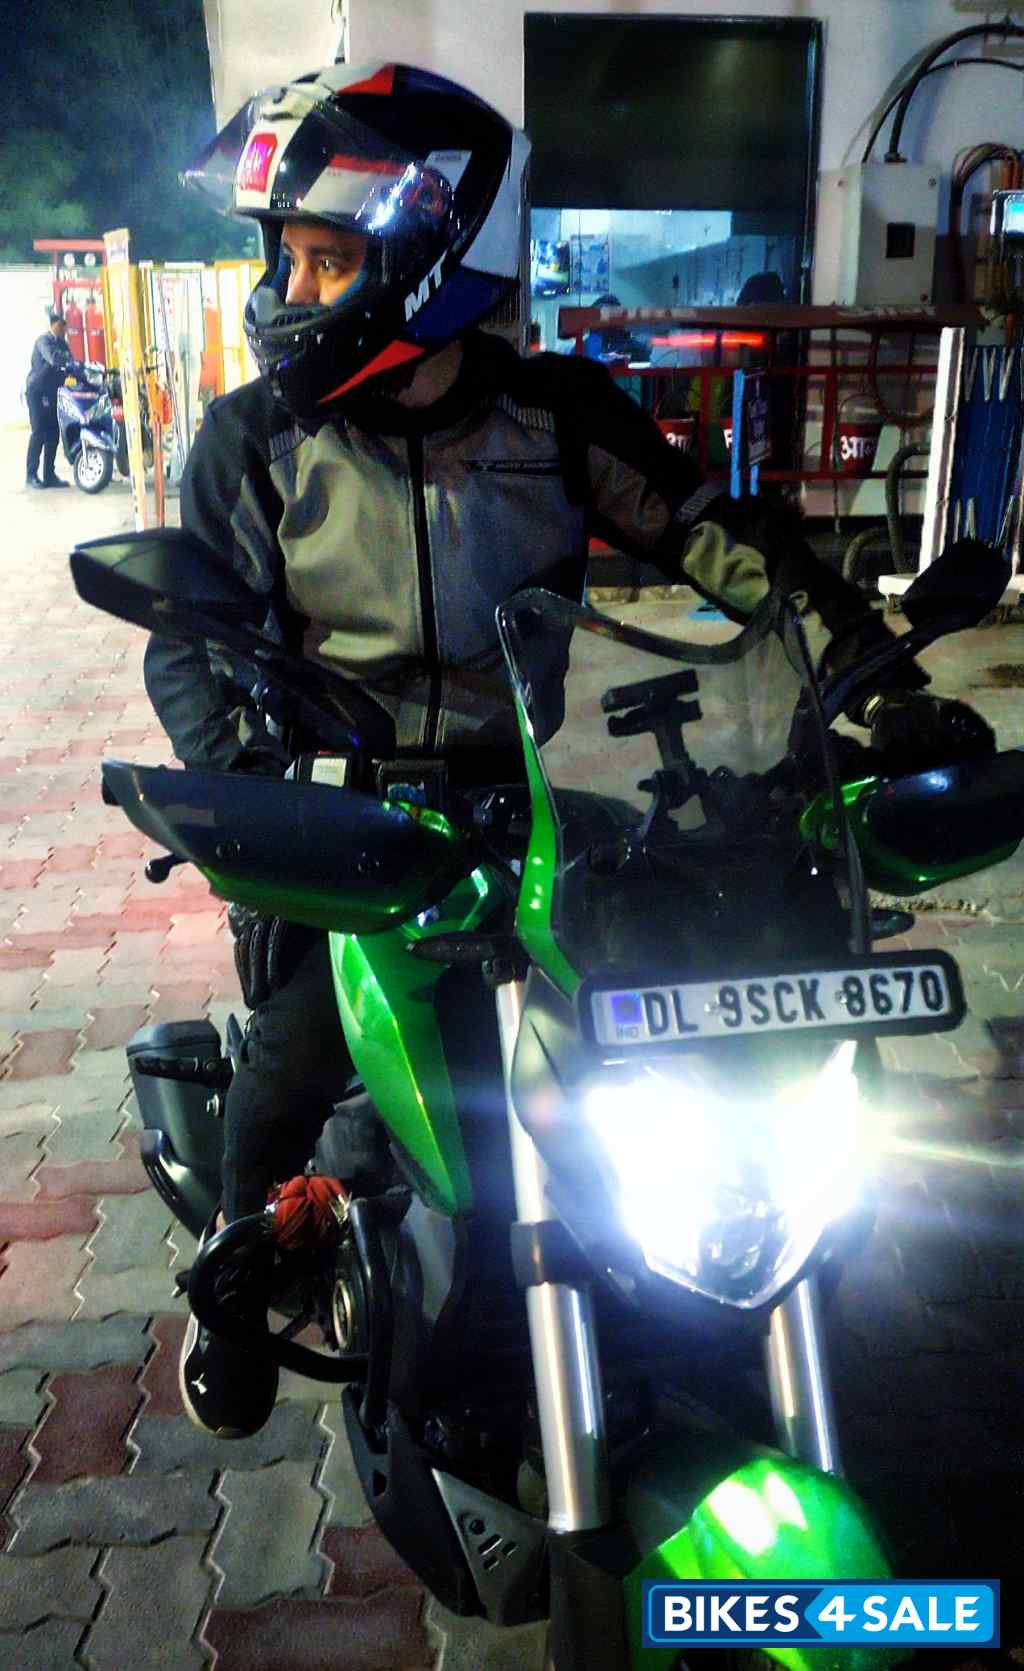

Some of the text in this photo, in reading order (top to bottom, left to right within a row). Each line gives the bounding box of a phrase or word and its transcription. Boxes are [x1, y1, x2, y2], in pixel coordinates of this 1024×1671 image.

[404, 248, 448, 322] MT
[643, 970, 943, 1036] DL 9SCK 8670
